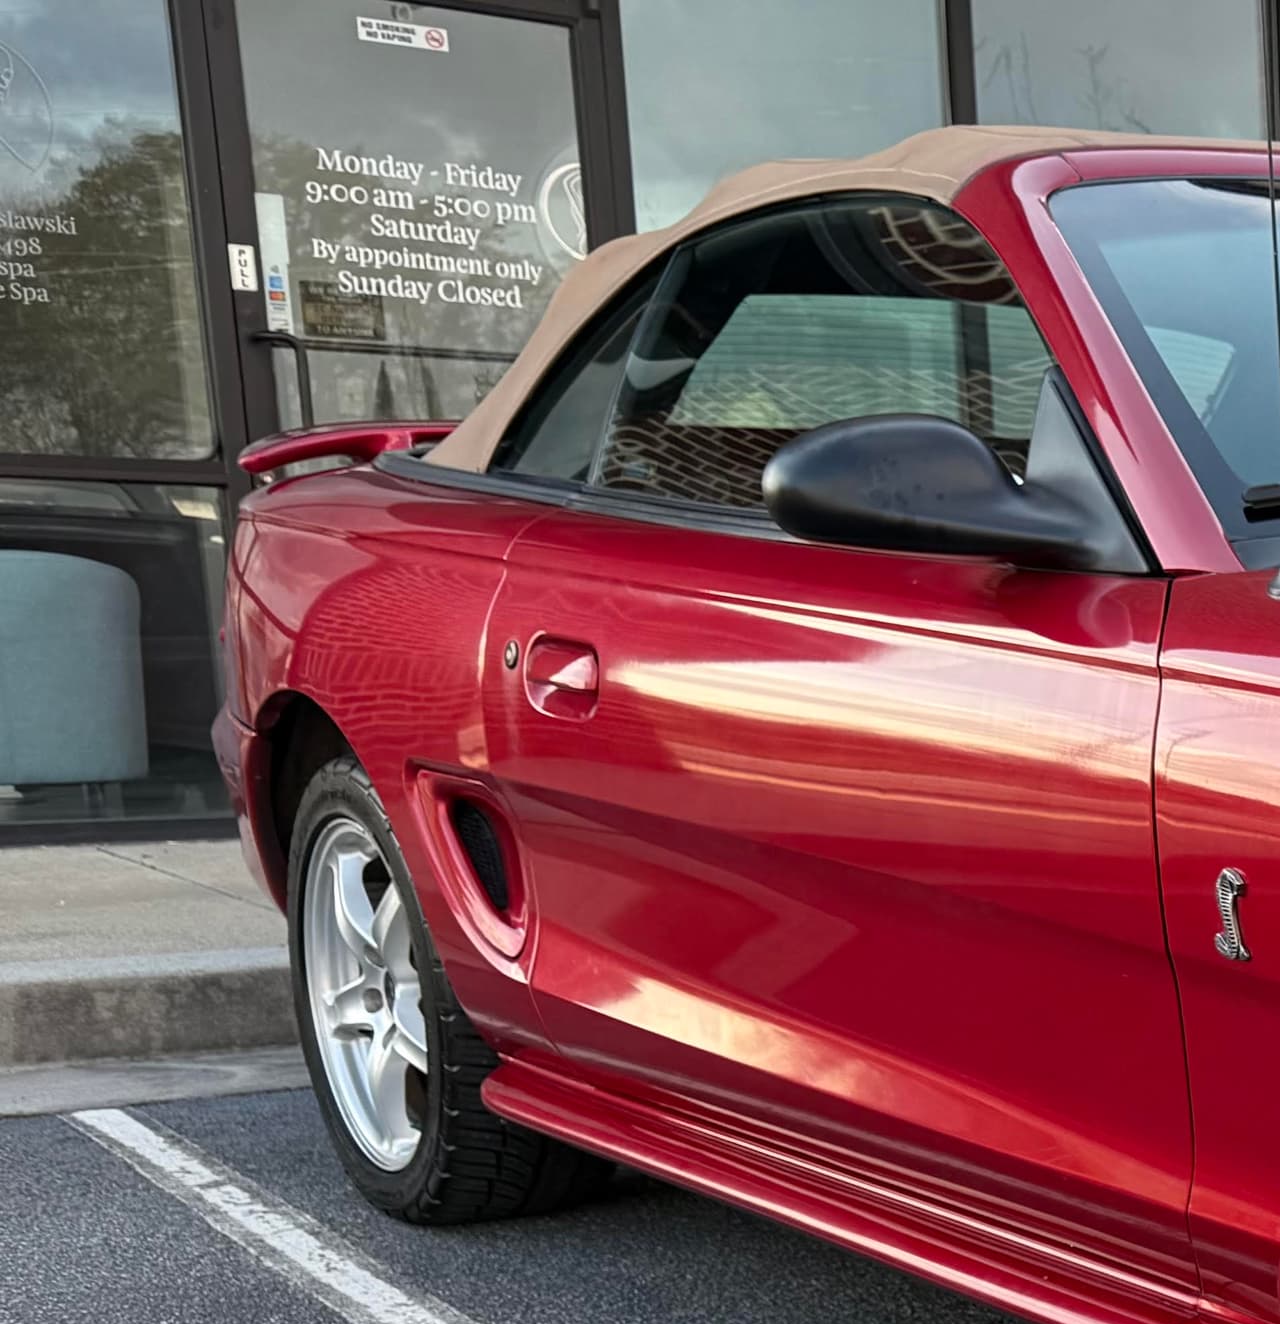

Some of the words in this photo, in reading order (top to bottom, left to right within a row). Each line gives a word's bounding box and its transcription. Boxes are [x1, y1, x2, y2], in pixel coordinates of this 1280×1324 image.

[316, 147, 424, 185] Monday
[445, 162, 522, 197] Friday
[305, 181, 368, 205] 9:00
[373, 188, 415, 210] am
[433, 194, 491, 218] 5:00
[496, 201, 537, 225] pm
[370, 214, 481, 250] Saturday
[238, 249, 249, 288] PULL
[311, 238, 341, 264] By
[345, 246, 492, 277] appointment
[495, 259, 543, 285] only
[10, 282, 51, 305] Spa
[338, 270, 434, 304] Sunday
[438, 280, 523, 308] Closed
